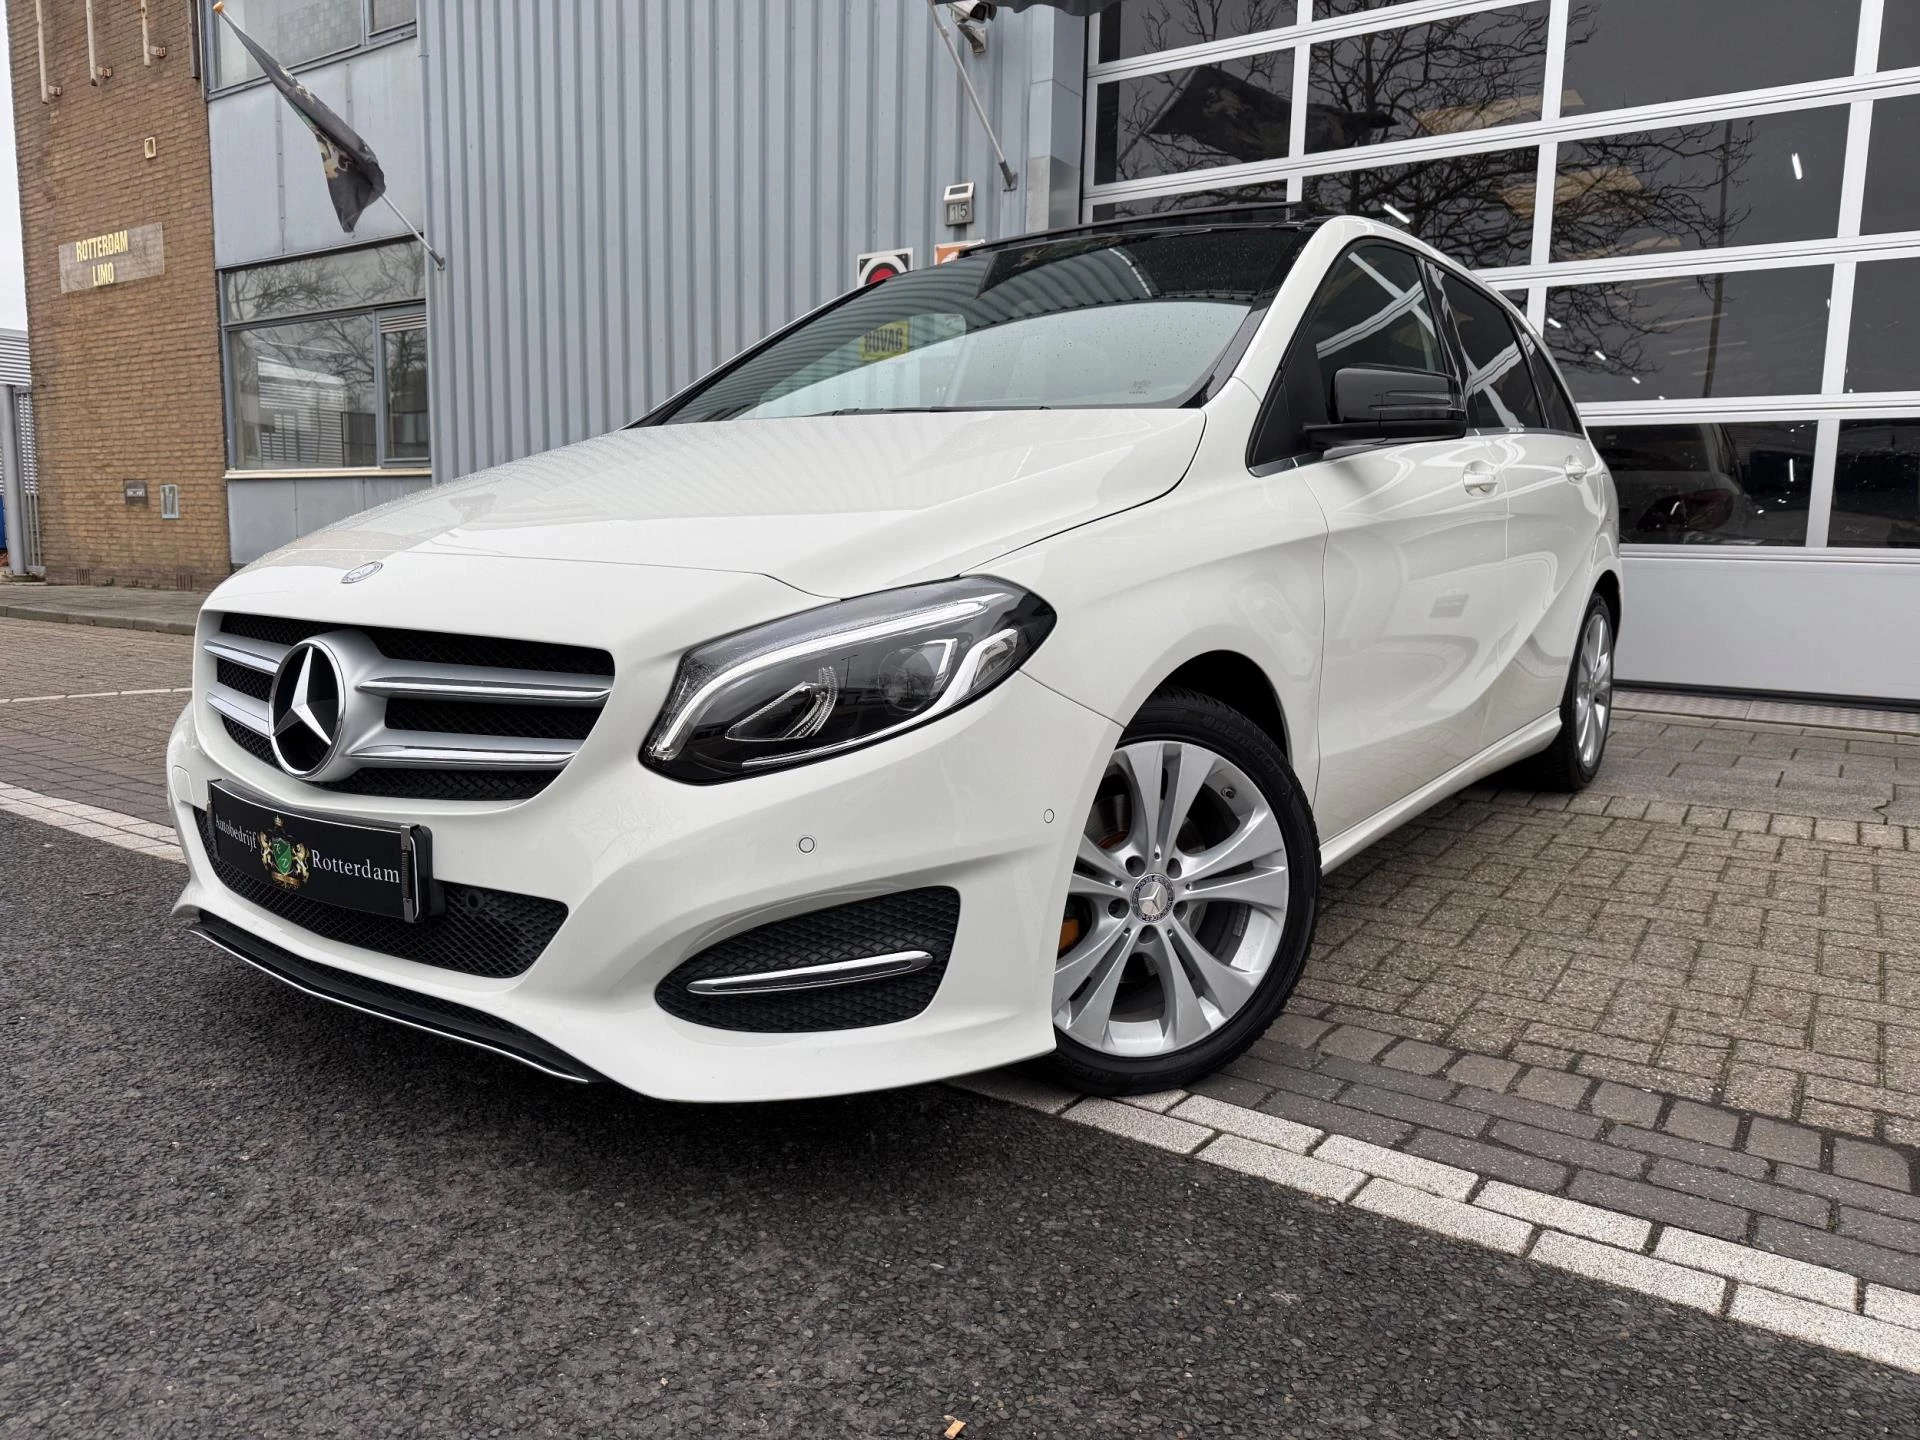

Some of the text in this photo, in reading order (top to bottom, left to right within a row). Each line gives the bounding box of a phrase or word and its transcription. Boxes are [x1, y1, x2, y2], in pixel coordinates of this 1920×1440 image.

[950, 202, 968, 220] 15
[76, 230, 129, 262] ROTTERDAM
[92, 262, 114, 286] LIMO
[215, 813, 400, 883] Autobedrijf Rotterdam
